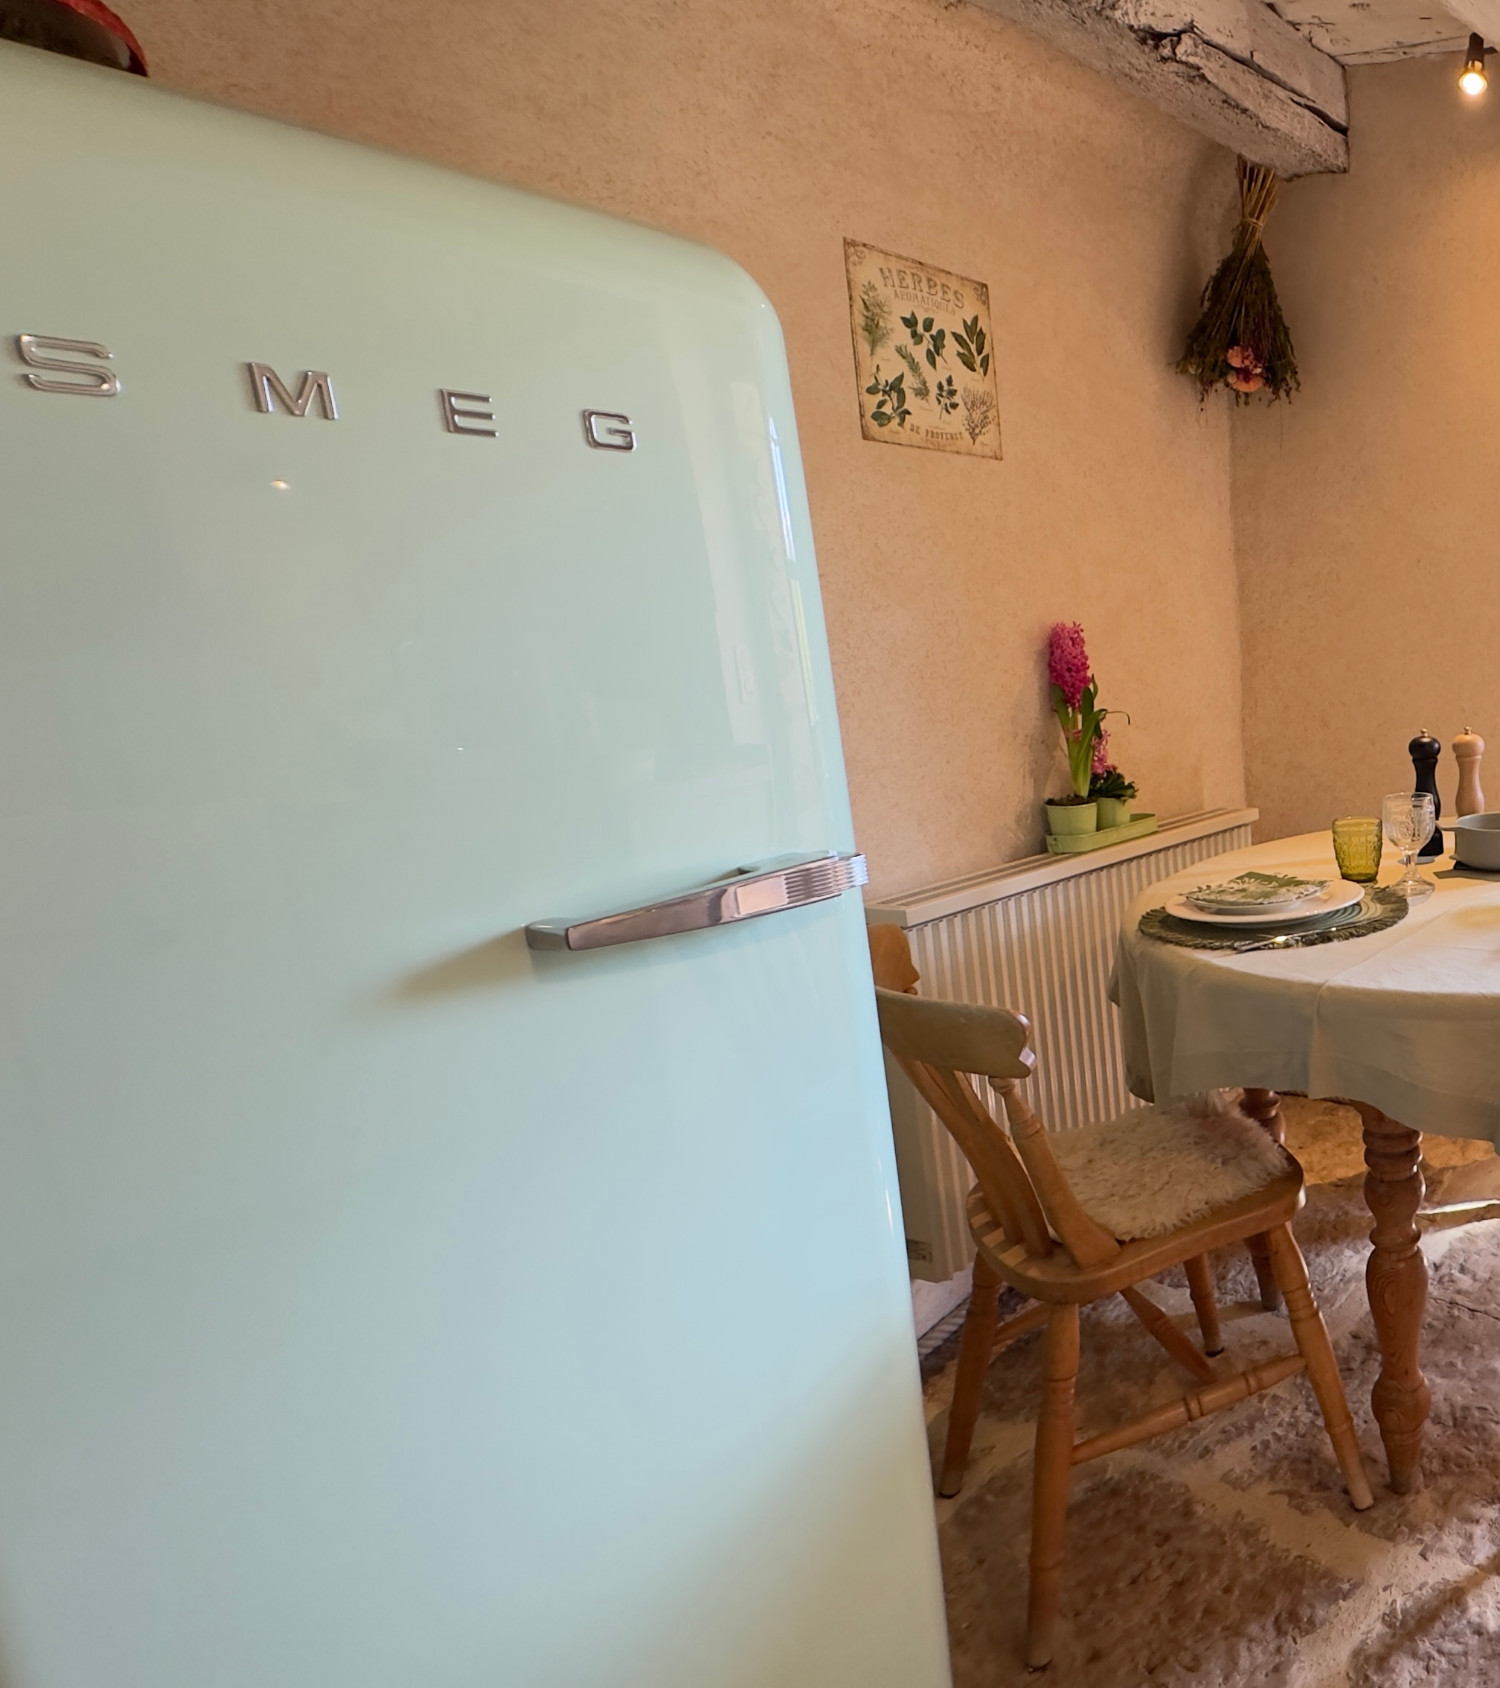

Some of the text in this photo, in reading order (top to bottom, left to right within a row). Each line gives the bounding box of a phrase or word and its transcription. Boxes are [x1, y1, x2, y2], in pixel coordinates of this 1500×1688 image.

[879, 267, 965, 309] HERBES
[15, 333, 637, 453] SMEG
[910, 423, 920, 435] DE
